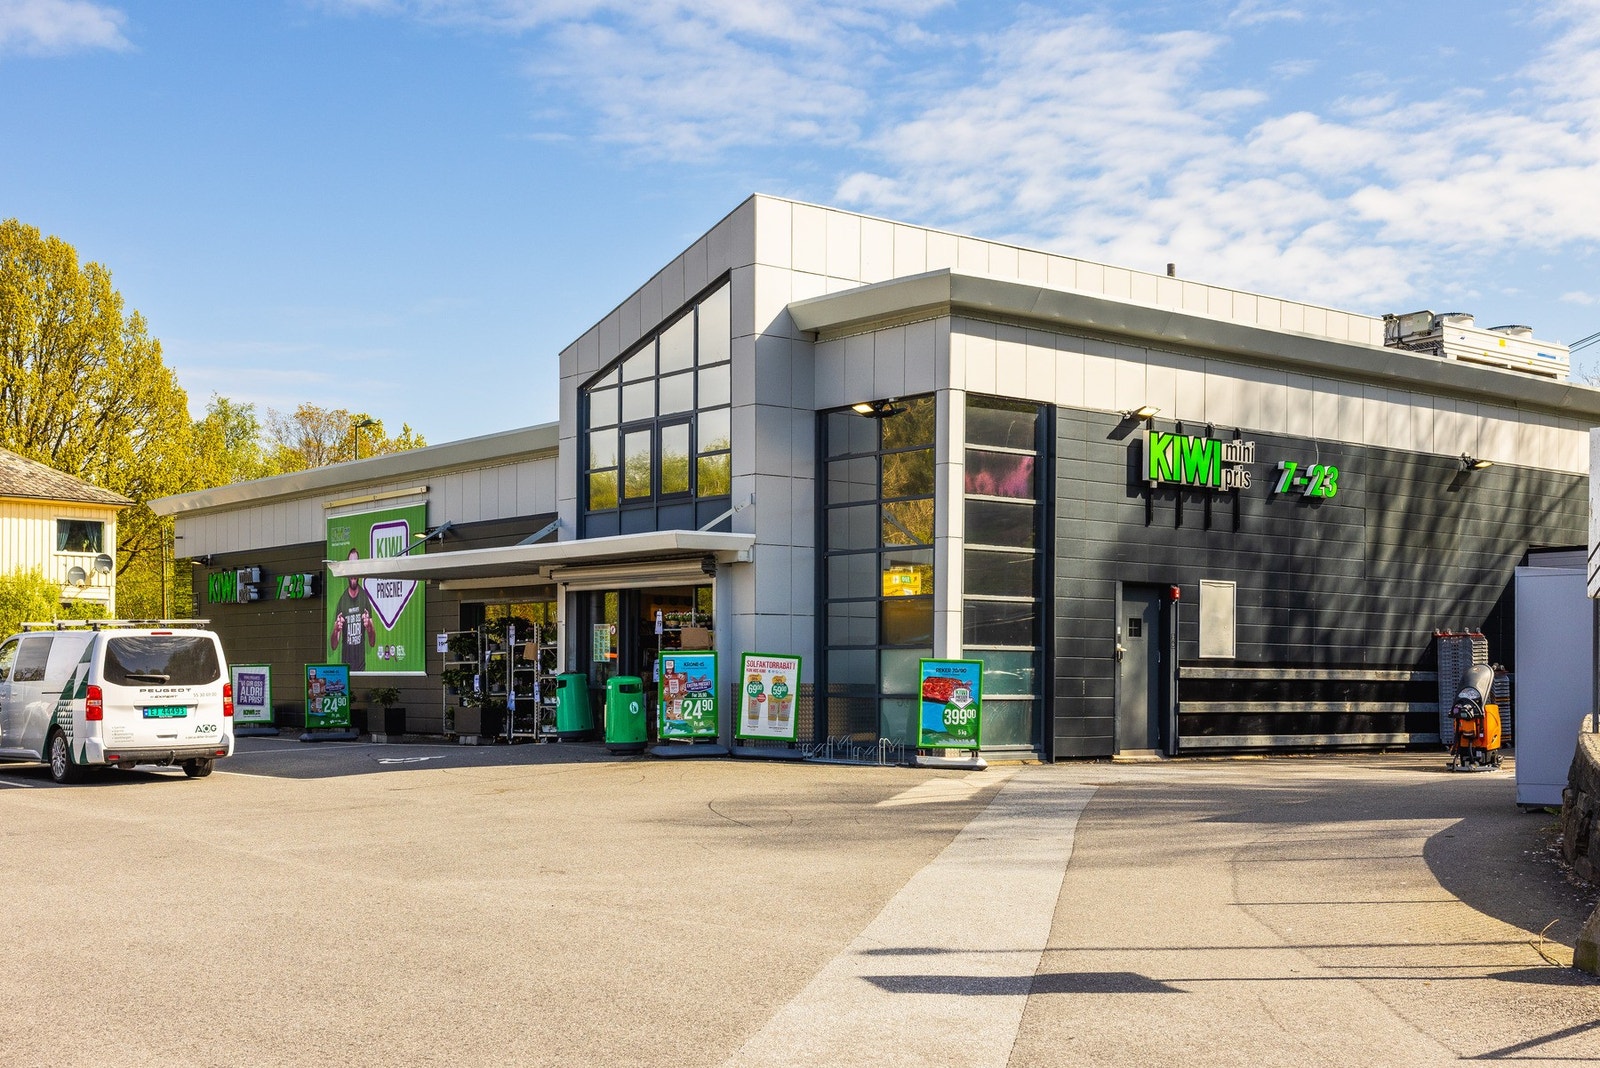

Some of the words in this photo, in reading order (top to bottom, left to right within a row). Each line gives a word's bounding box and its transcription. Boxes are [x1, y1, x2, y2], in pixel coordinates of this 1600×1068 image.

[1149, 431, 1223, 487] KIWI
[1225, 441, 1255, 463] mini
[1281, 460, 1340, 499] 7-23
[1225, 469, 1251, 490] pris
[376, 535, 403, 558] KIWI
[208, 570, 238, 603] KIWI
[275, 573, 305, 600] 7-23
[376, 580, 403, 599] PRISENE!
[240, 686, 263, 697] ALDRI
[150, 707, 159, 715] EJ
[161, 707, 185, 715] 44493
